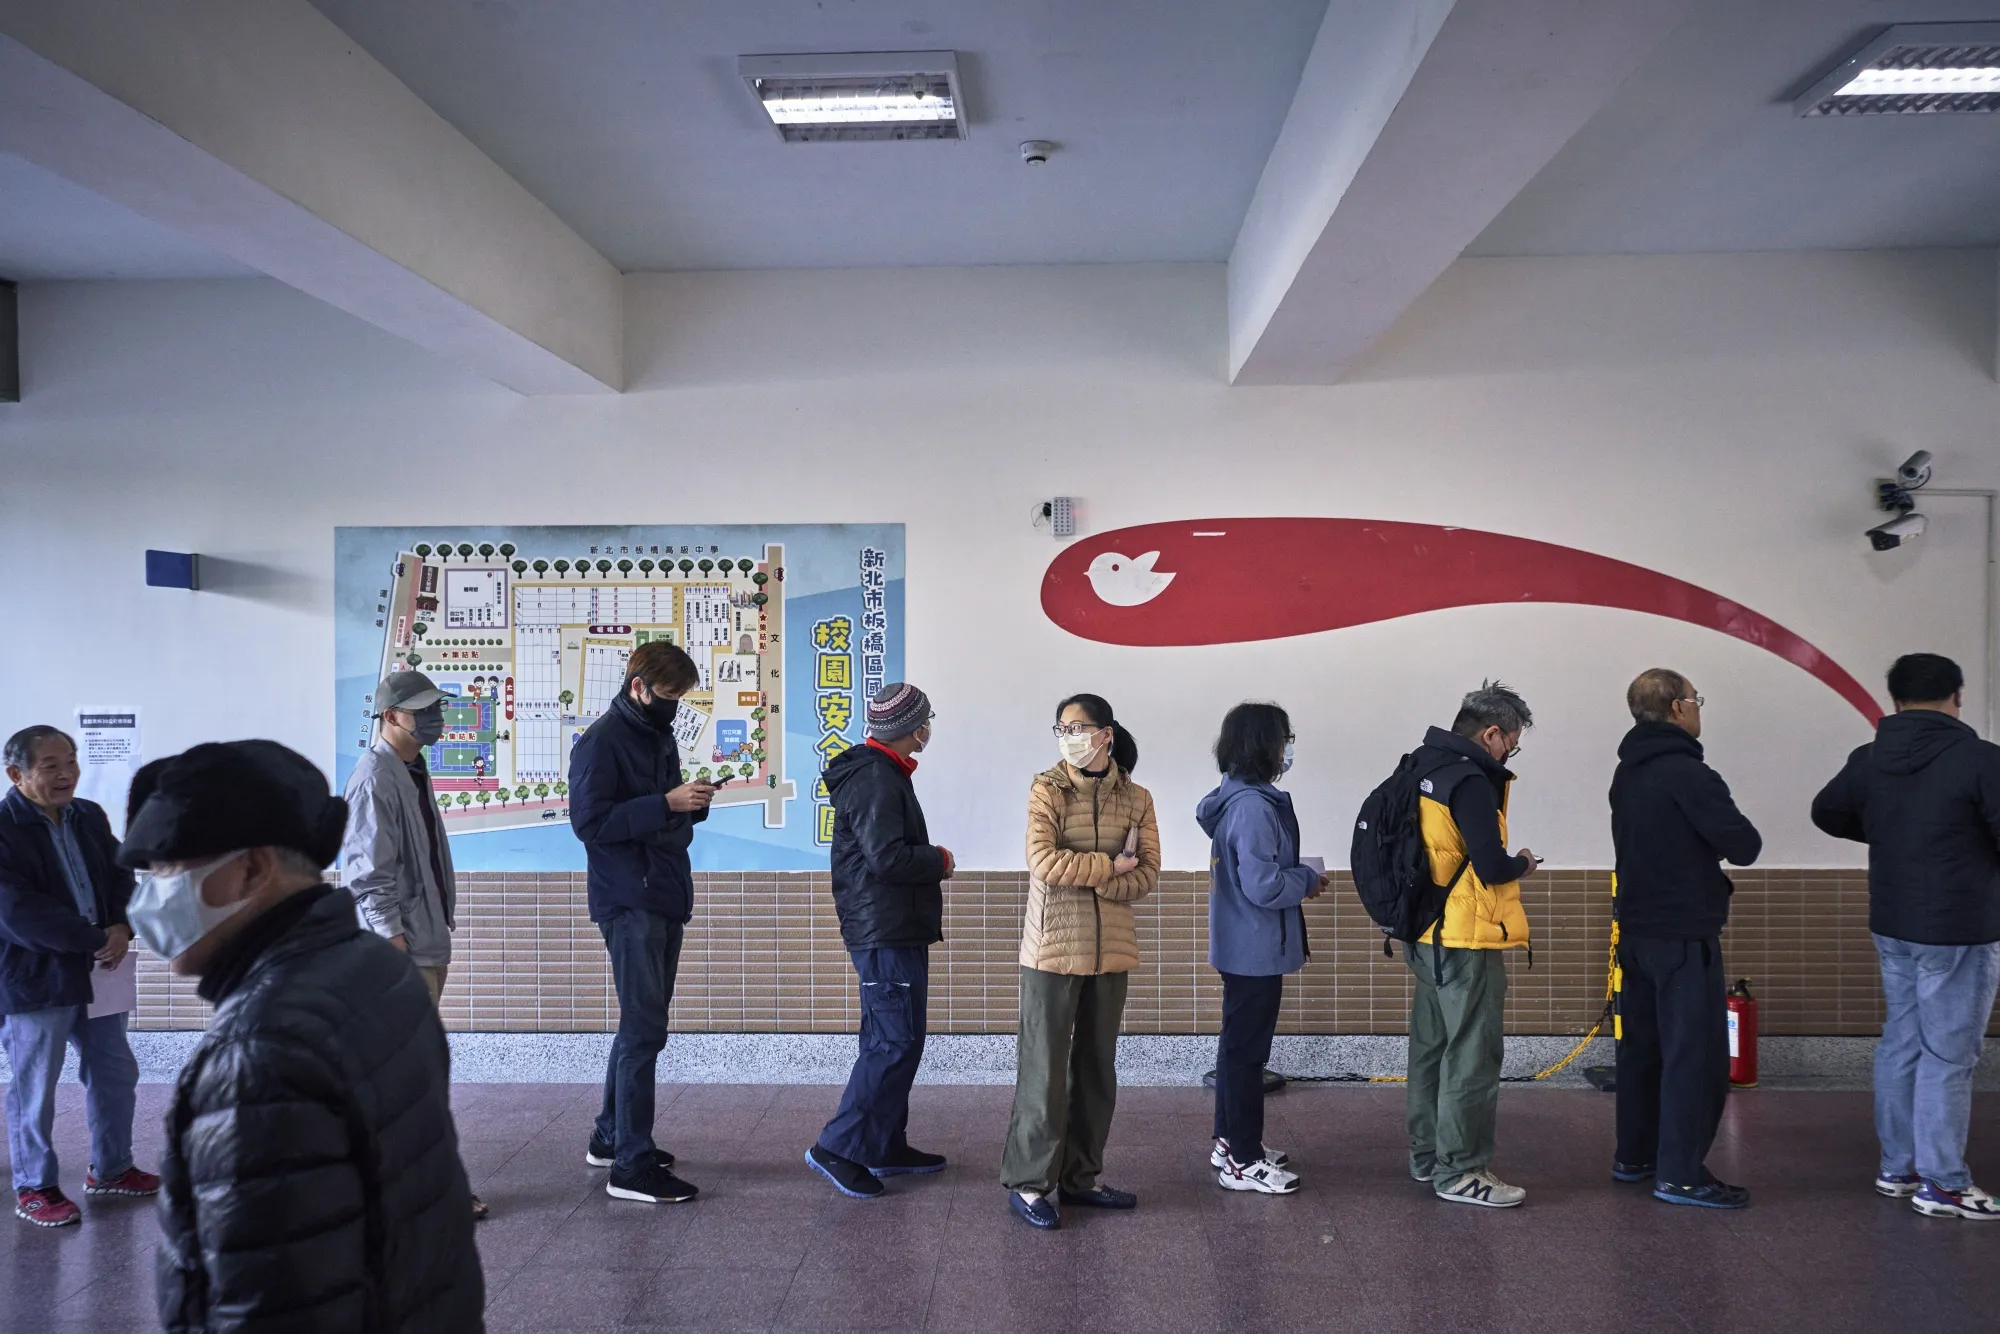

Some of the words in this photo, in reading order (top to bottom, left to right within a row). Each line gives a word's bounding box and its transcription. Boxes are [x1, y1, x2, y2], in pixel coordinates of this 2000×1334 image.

[590, 546, 719, 555] 新北市板橋高級中學
[863, 548, 884, 738] 新北市板橋區國
[452, 651, 479, 659] 集結點
[770, 634, 780, 713] 文化路
[449, 732, 476, 740] 集結點
[1254, 1168, 1269, 1181] N
